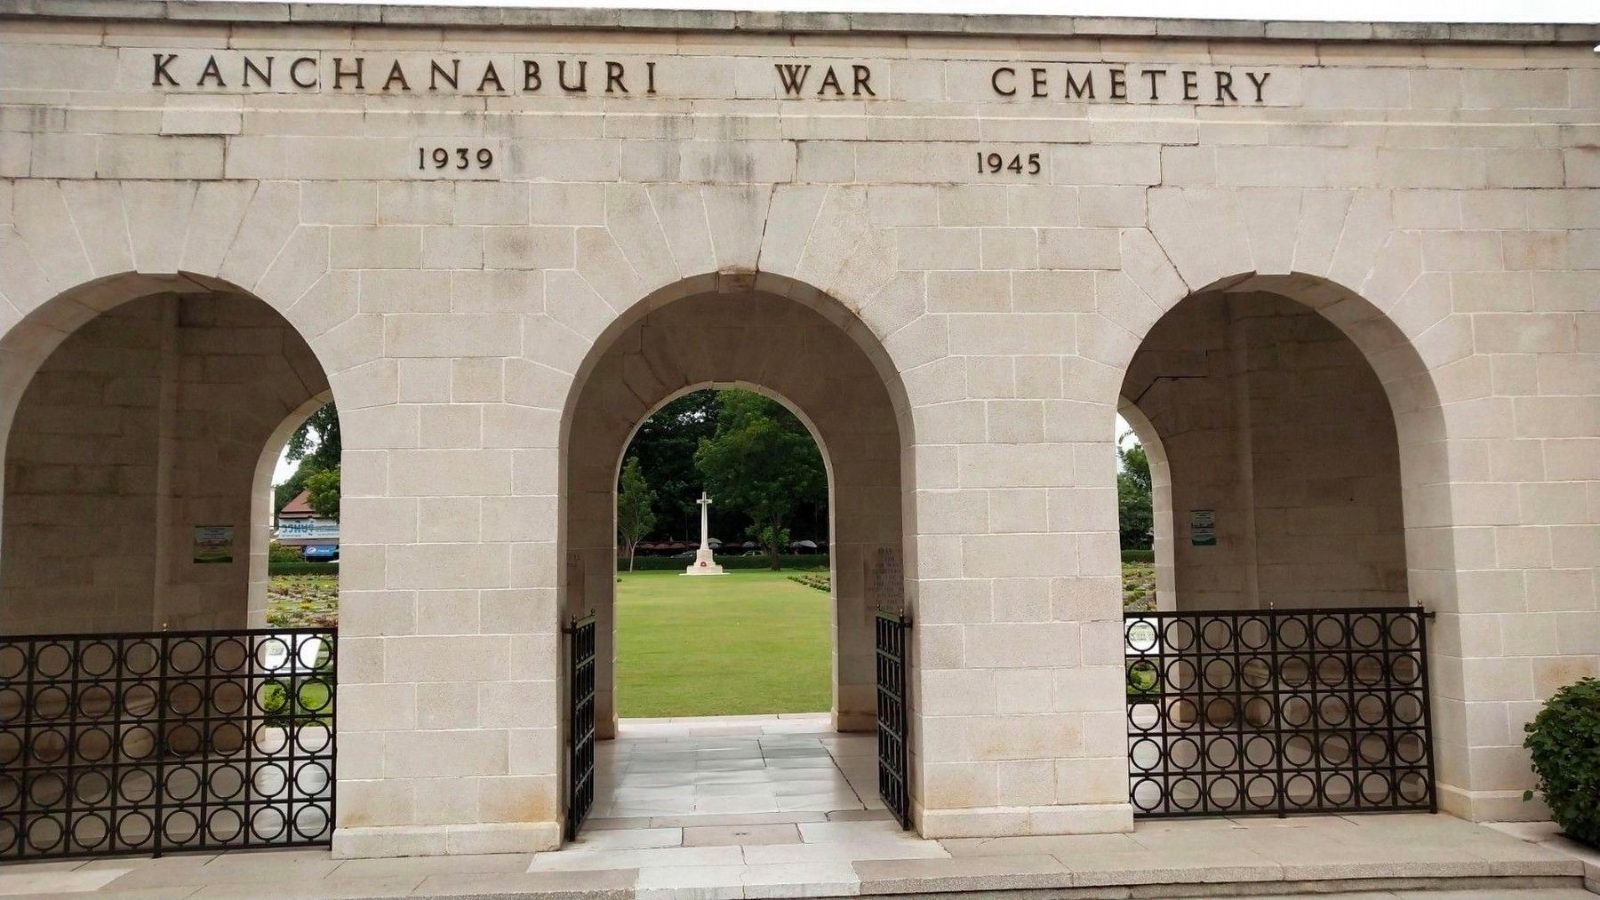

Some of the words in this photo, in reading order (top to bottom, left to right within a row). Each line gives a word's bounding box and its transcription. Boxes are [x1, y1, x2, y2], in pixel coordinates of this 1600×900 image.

[151, 53, 658, 94] KANCHANABURI
[774, 63, 876, 98] WAR
[991, 67, 1271, 103] CEMETERY
[418, 147, 493, 170] 1939
[977, 152, 1041, 176] 1945
